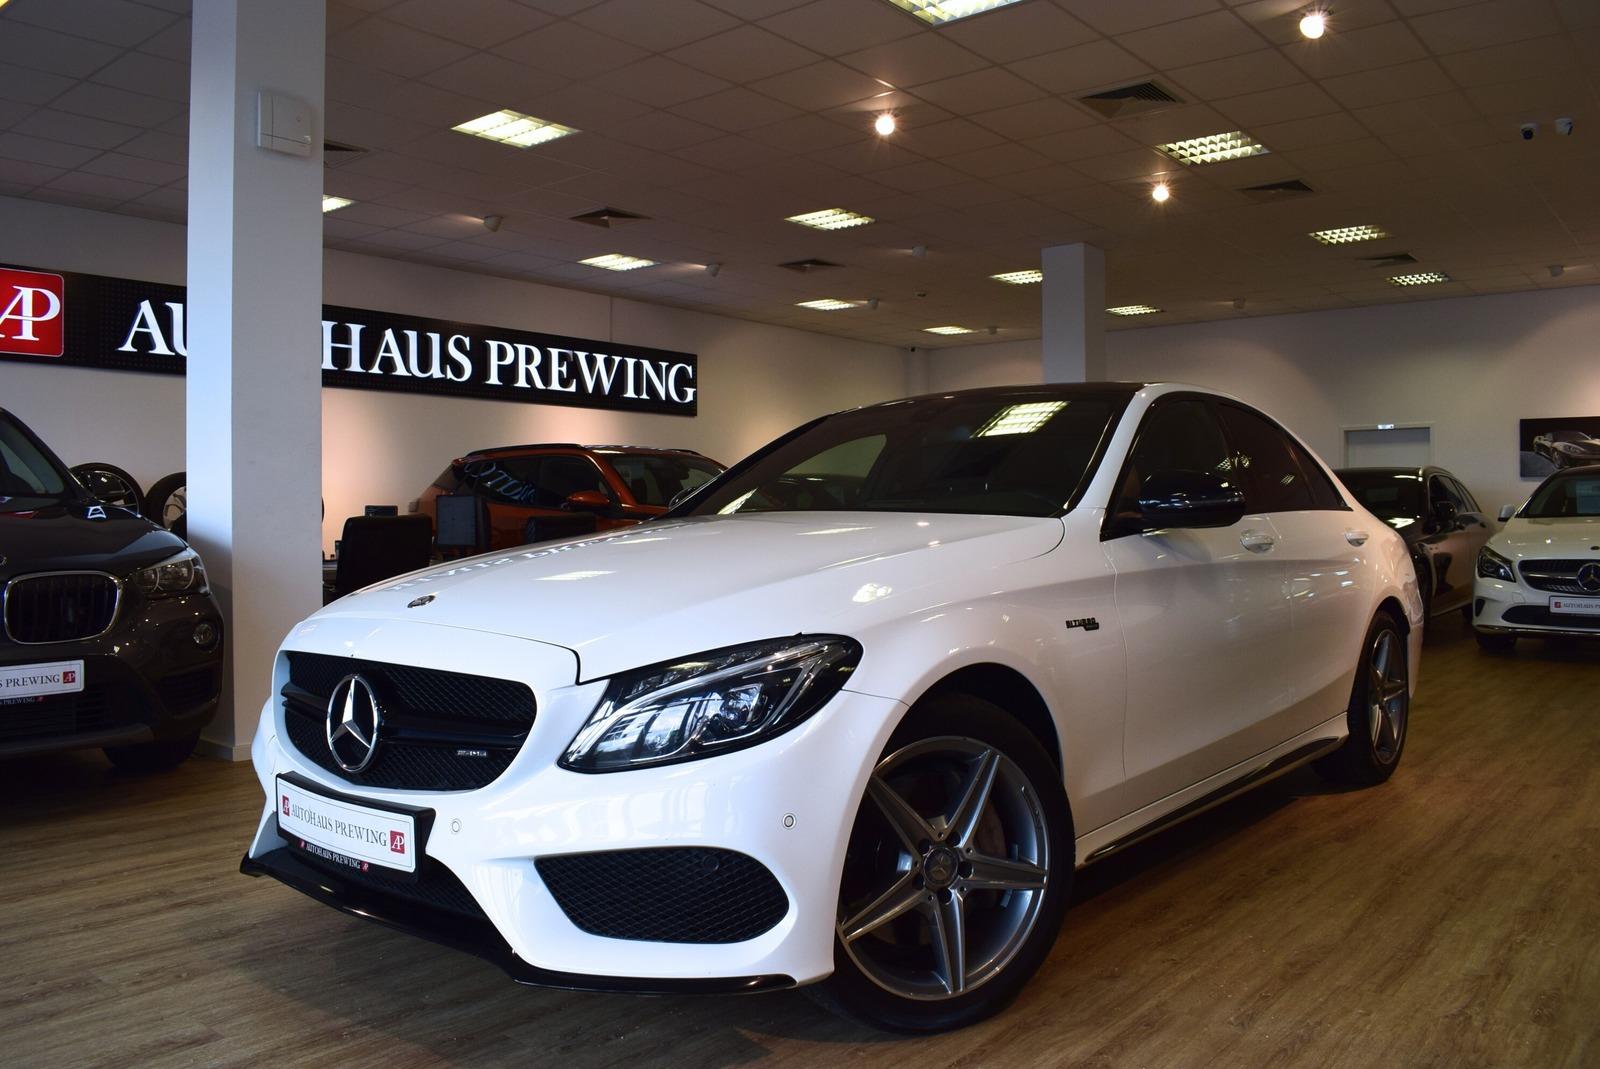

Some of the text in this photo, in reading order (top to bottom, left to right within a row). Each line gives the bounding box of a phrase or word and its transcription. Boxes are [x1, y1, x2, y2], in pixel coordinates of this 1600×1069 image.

[484, 339, 697, 403] PREWING
[6, 674, 60, 688] PREWING
[291, 803, 333, 832] AUTOHAUS
[335, 819, 387, 847] PREWING
[391, 835, 404, 850] AP
[332, 852, 361, 869] PREWING
